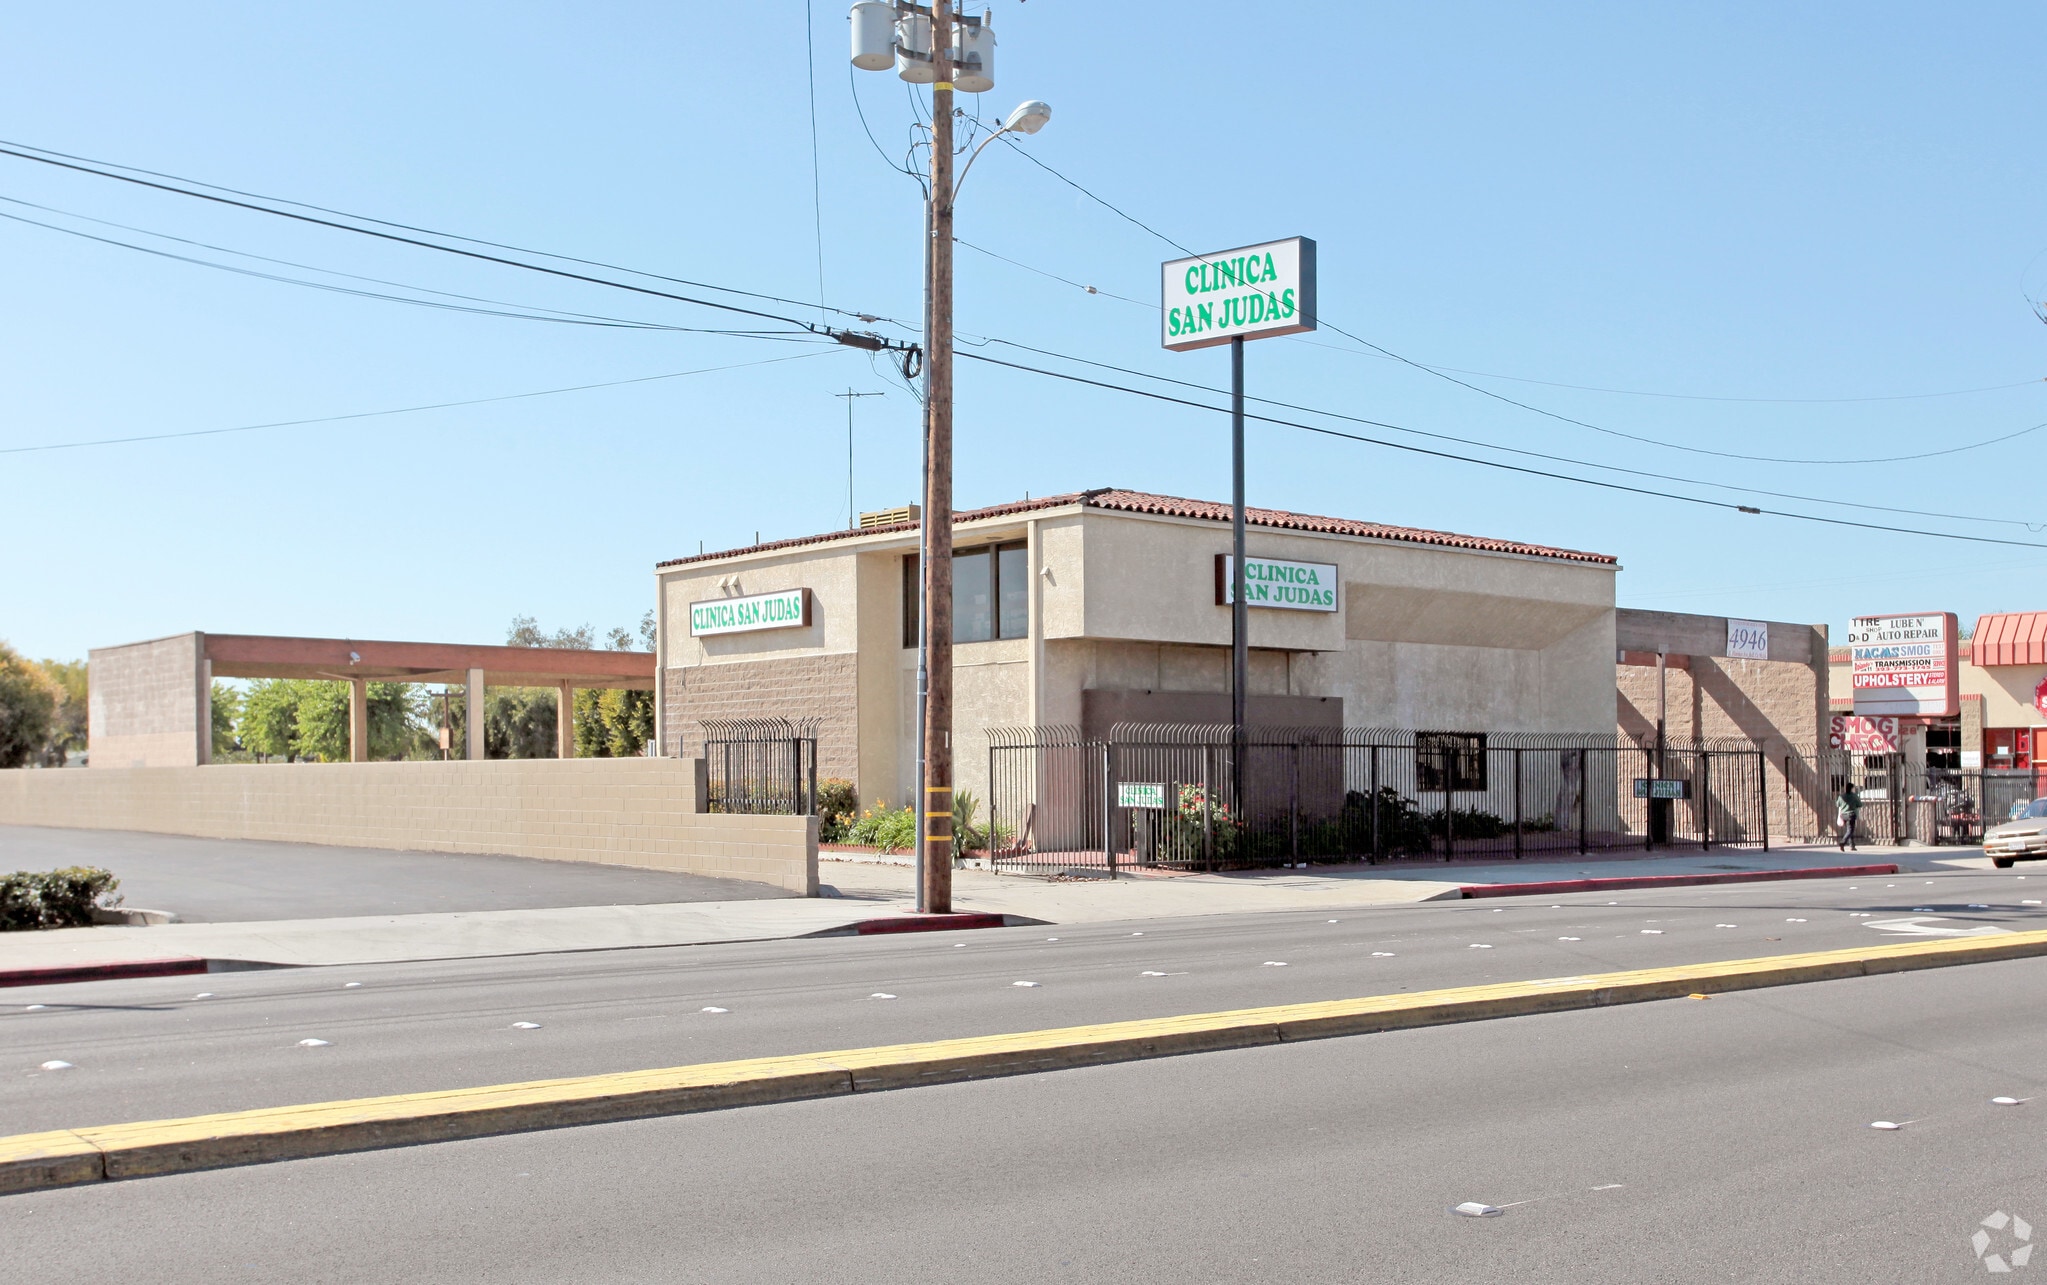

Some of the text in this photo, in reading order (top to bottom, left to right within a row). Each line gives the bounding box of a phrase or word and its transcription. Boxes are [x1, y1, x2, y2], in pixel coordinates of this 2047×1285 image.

[1185, 252, 1277, 295] CLINICA
[1169, 288, 1295, 336] SAN JUDAS
[1245, 563, 1319, 585] CLINICA
[1231, 583, 1334, 606] AN JUDAS
[693, 596, 800, 630] CLINICA SAN JUDAS
[1891, 618, 1914, 628] LUBE
[1729, 628, 1766, 651] 4946
[1849, 633, 1856, 642] D
[1862, 633, 1869, 642] D
[1877, 629, 1938, 640] AUTO REPAIR
[1901, 644, 1930, 656] SMOG
[1875, 659, 1931, 668] TRANSMISSION
[1854, 672, 1929, 687] UPHOLSTERY
[1831, 716, 1893, 735] SMOG
[1830, 733, 1897, 751] CHECK
